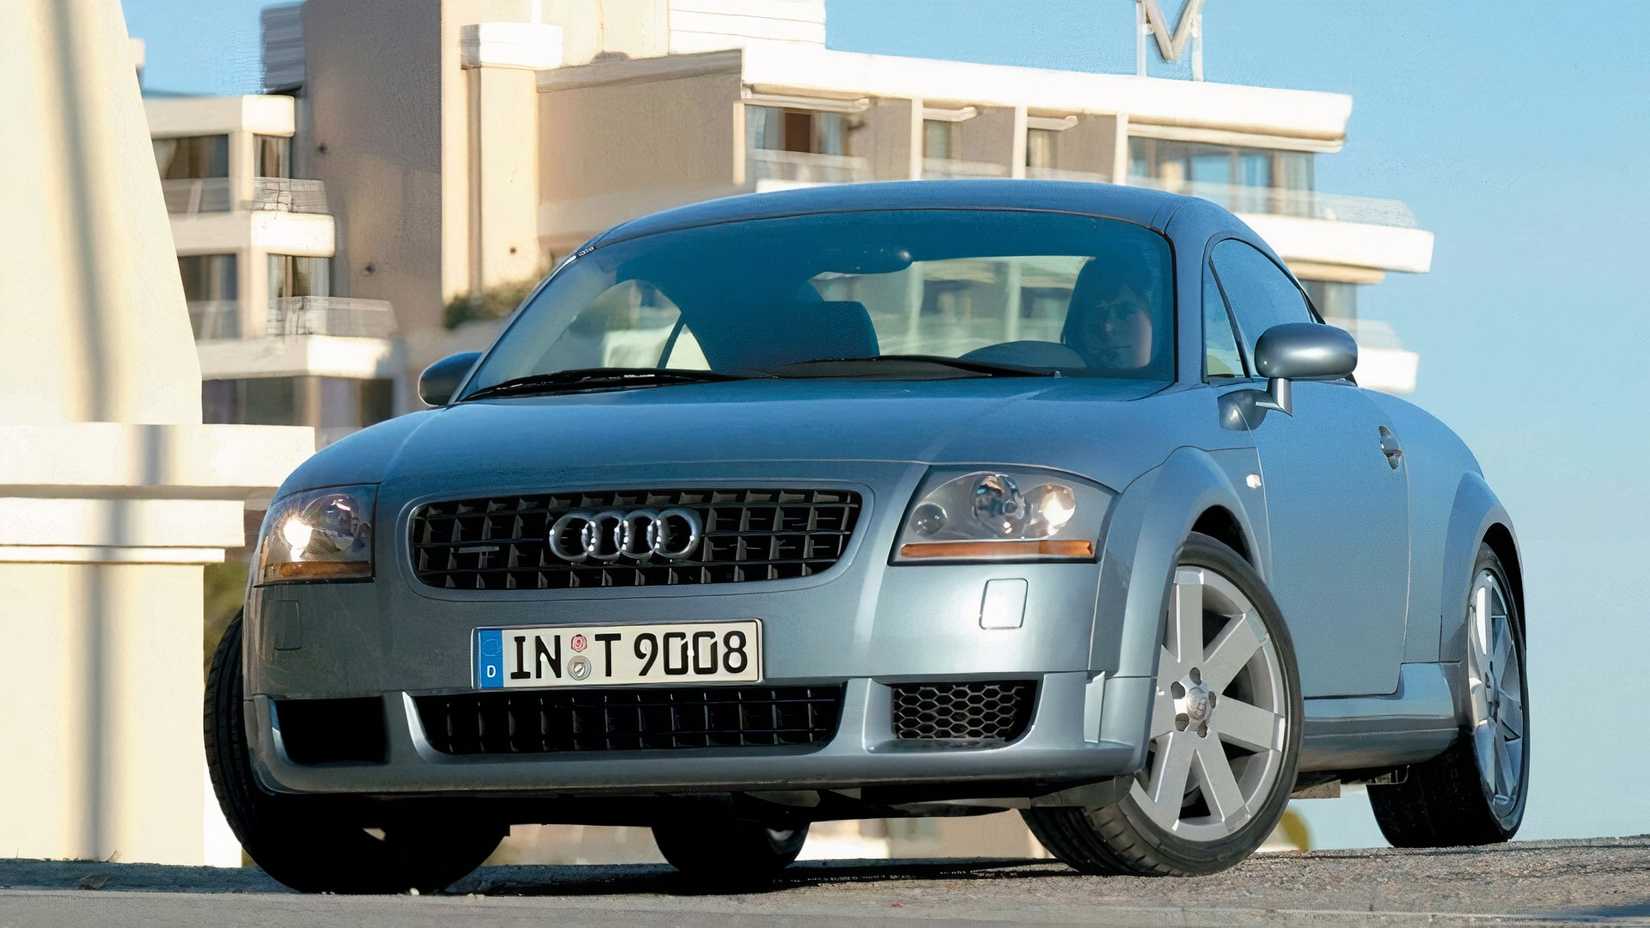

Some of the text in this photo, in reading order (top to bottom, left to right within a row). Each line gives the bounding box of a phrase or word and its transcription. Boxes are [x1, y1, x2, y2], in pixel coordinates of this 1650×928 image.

[510, 635, 562, 679] IN
[594, 633, 622, 677] T
[633, 630, 748, 676] 9008
[487, 665, 496, 678] D
